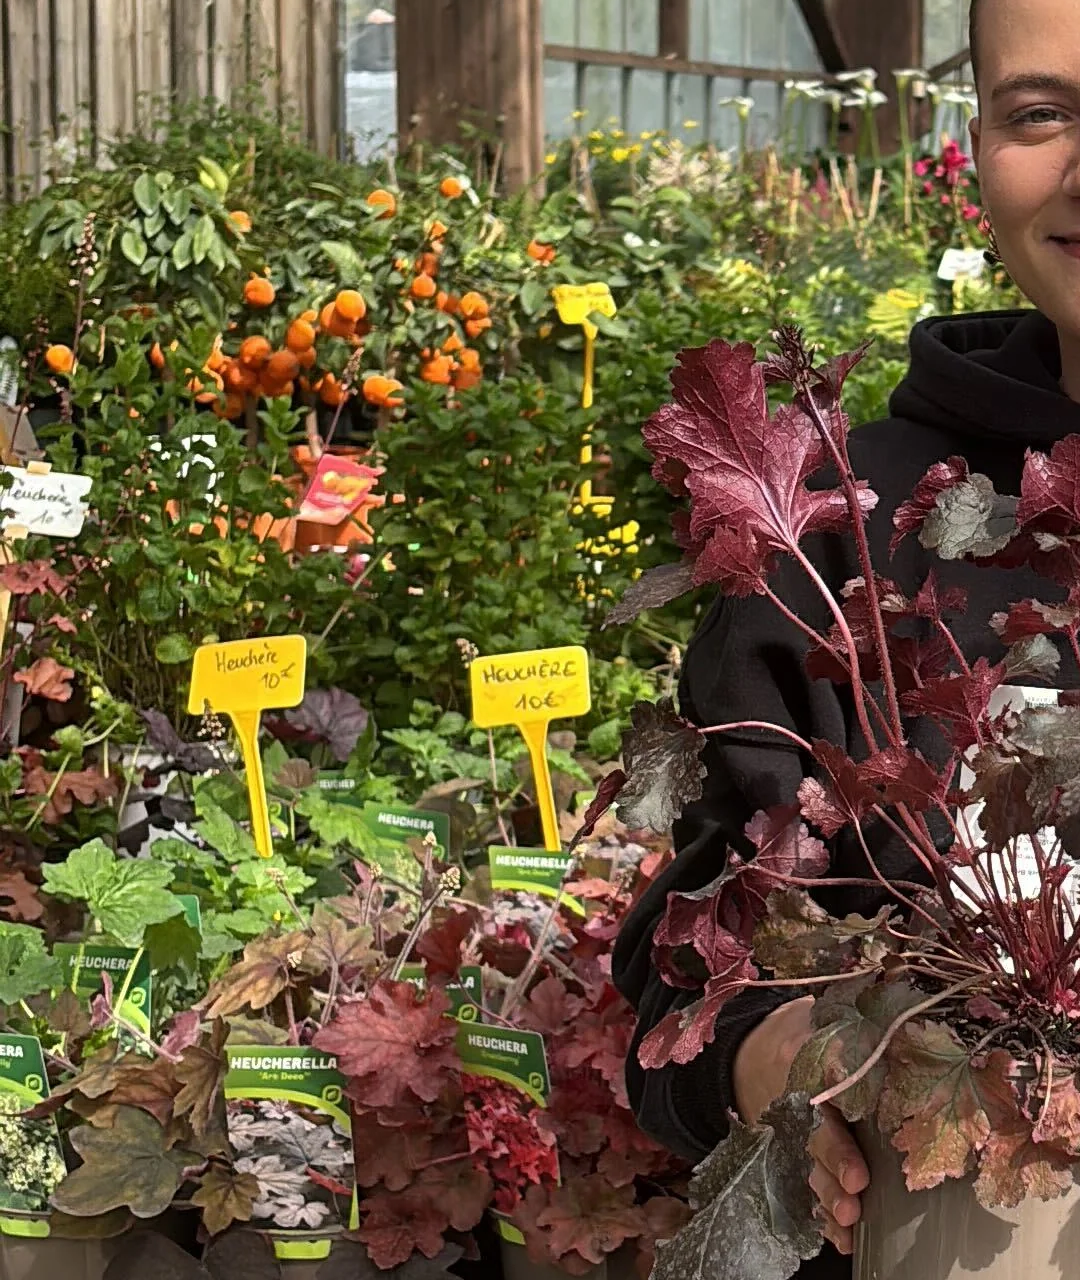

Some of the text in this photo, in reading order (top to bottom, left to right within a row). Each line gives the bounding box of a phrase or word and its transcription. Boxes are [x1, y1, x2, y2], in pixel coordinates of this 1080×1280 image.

[215, 642, 278, 674] Heuchère
[514, 691, 561, 710] 10€
[377, 811, 434, 831] HEUCHERA
[467, 1033, 529, 1056] HEUCHERA
[230, 1056, 338, 1070] HEUCHERELLA
